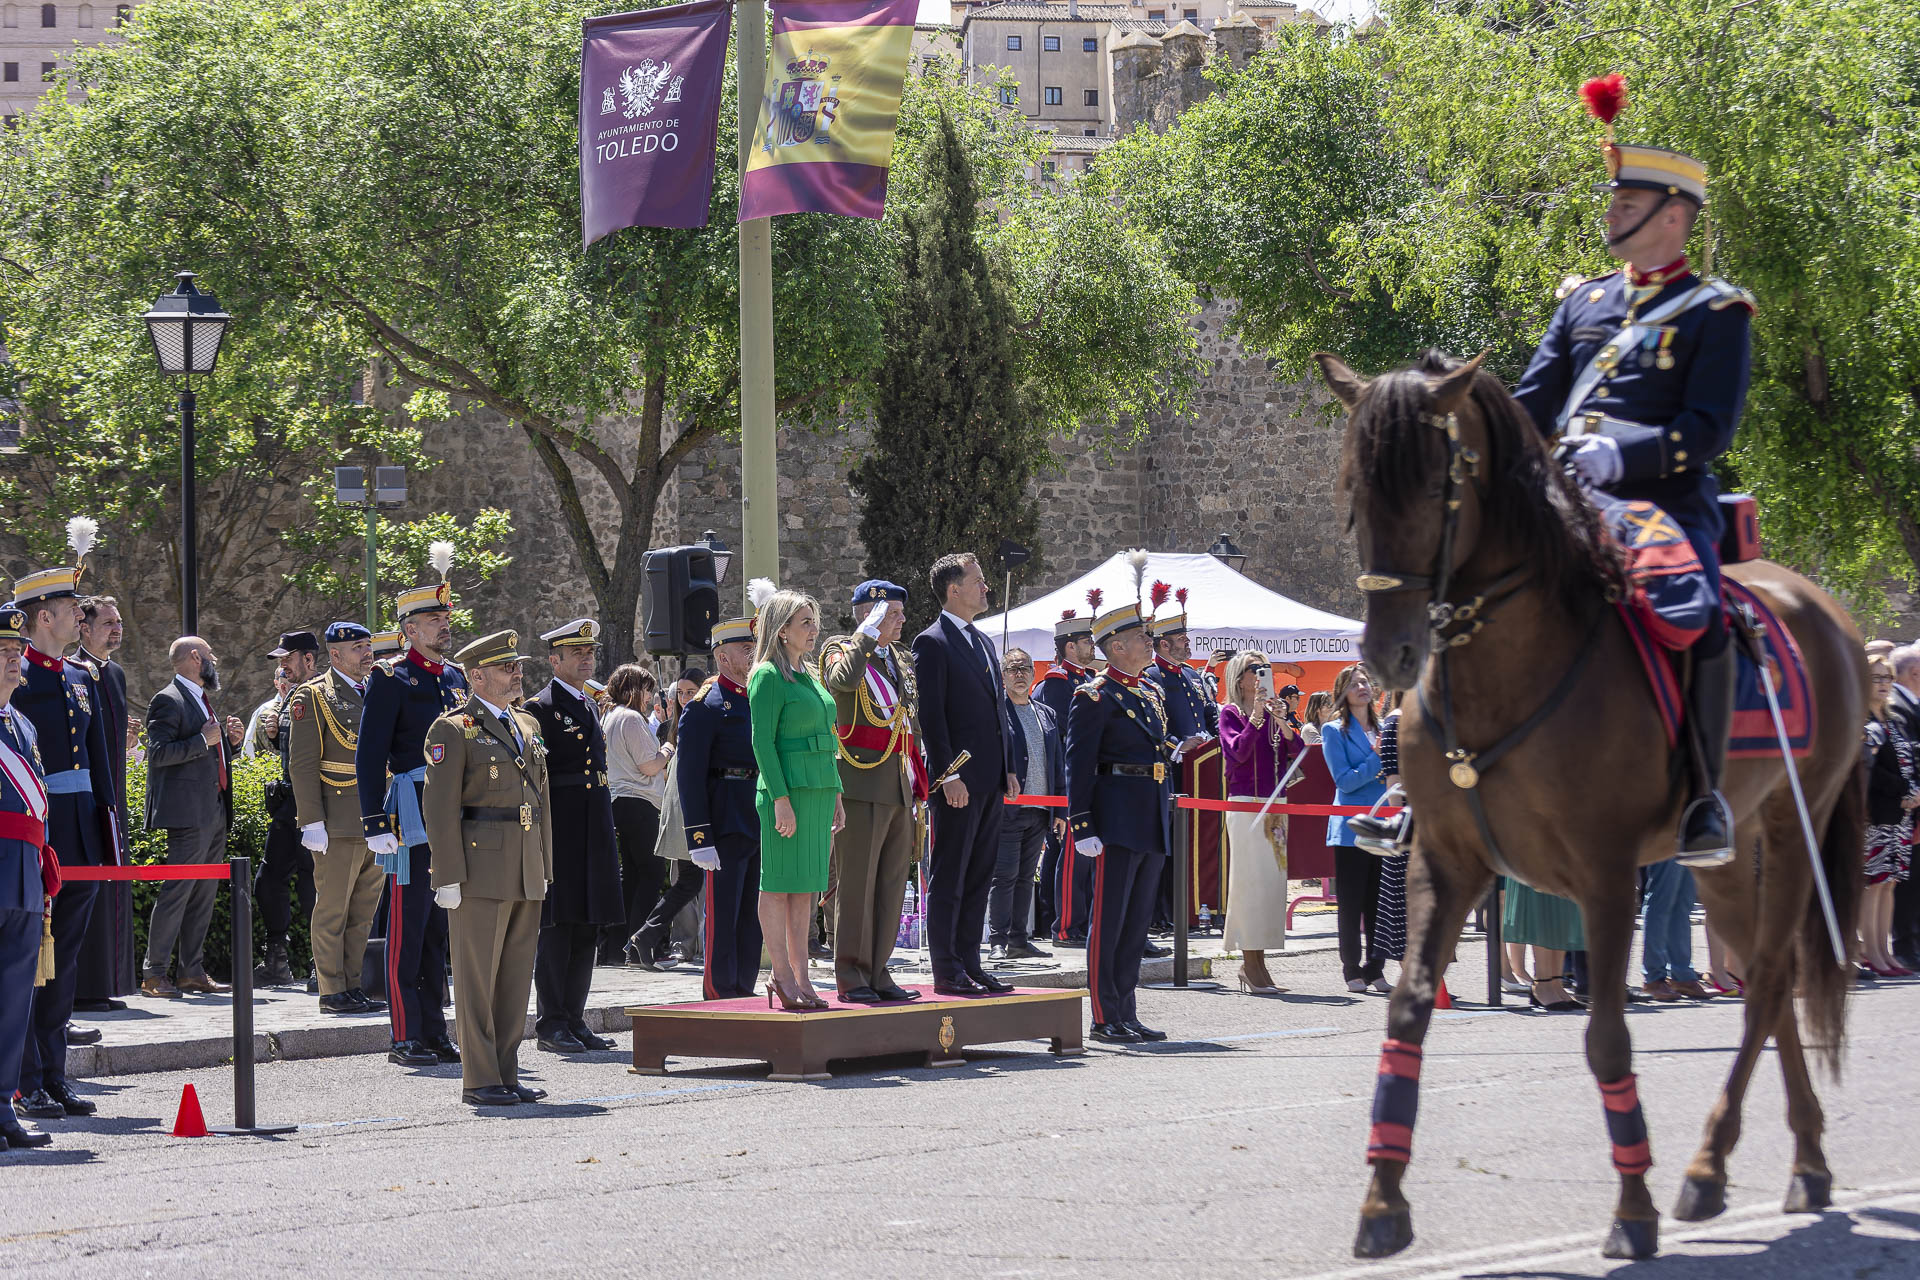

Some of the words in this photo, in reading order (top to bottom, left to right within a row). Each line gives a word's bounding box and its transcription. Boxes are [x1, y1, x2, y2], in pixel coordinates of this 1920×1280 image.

[598, 120, 663, 140] AYUNTAMIENTO
[666, 119, 680, 128] DE
[596, 132, 679, 164] TOLEDO
[1195, 635, 1263, 652] PROTECCIÓN
[1266, 639, 1291, 655] CIVIL
[1293, 639, 1307, 654] DE
[1309, 638, 1350, 653] TOLEDO
